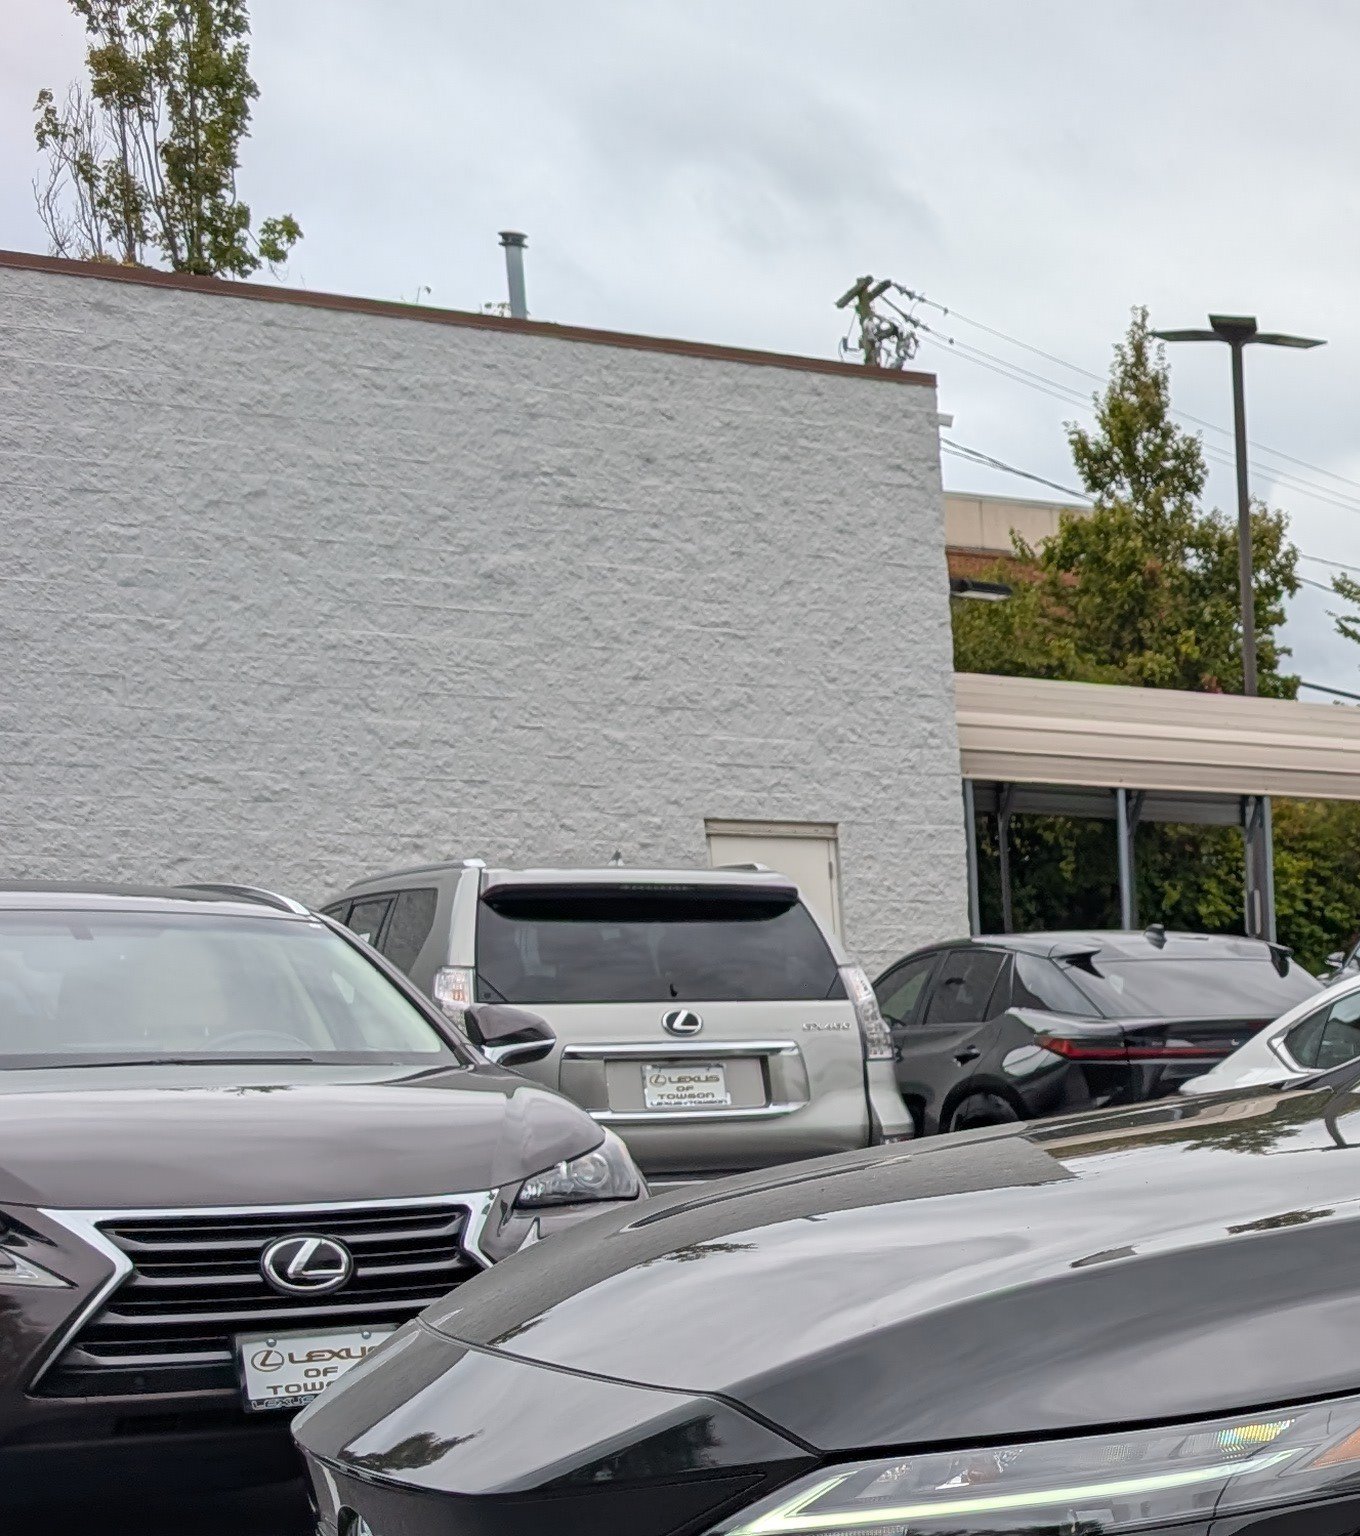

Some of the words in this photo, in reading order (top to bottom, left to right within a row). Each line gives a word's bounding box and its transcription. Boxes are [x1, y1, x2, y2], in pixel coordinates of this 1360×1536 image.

[668, 1075, 720, 1084] LEXUS
[676, 1085, 695, 1093] OF
[657, 1092, 715, 1100] TOWSON
[303, 1366, 338, 1379] OF
[266, 1381, 334, 1395] TOW
